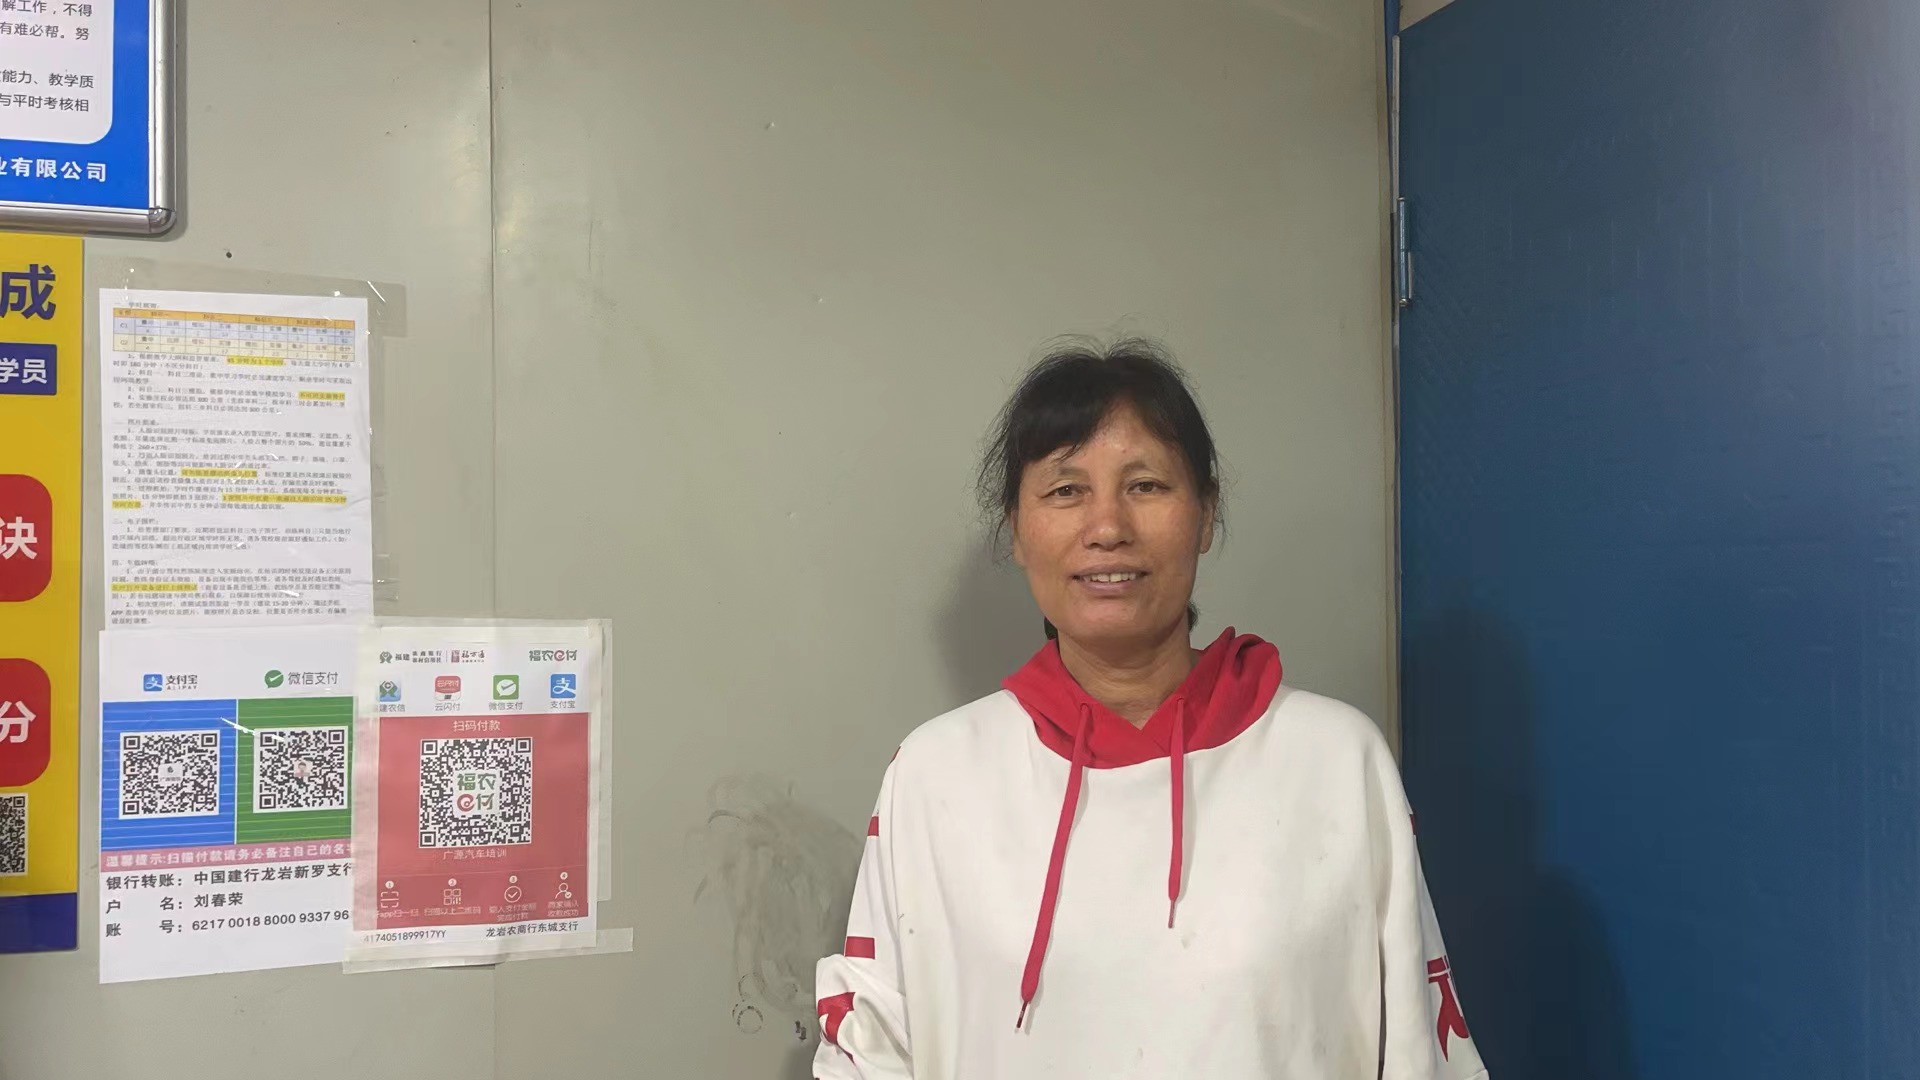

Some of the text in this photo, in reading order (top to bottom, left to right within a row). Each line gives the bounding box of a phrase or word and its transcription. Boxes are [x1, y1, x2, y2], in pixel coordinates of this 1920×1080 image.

[0, 69, 94, 88] 能力、教学质
[0, 92, 89, 112] 与平时考核相
[0, 264, 56, 320] 成
[0, 357, 48, 384] 学员
[166, 674, 198, 685] 支付宝
[287, 671, 338, 685] 微信支付
[374, 702, 406, 713] 建农信
[434, 703, 461, 712] 云闪付
[488, 702, 523, 711] 微信支付
[550, 700, 576, 710] 支付宝
[452, 719, 501, 732] 扫码付款
[456, 772, 497, 791] 福农
[442, 848, 507, 861] 广源汽车培训
[194, 862, 352, 886] 中国建行龙岩新罗支行
[106, 899, 122, 915] 户
[193, 892, 244, 909] 刘春荣
[106, 923, 122, 938] 账
[192, 919, 225, 931] 6217
[228, 917, 261, 928] 0018
[264, 914, 296, 925] 8000
[299, 912, 331, 923] 9337
[333, 910, 350, 921] 96
[486, 921, 579, 938] 龙岩农商行东城支行
[363, 930, 447, 942] 4174051899917YY
